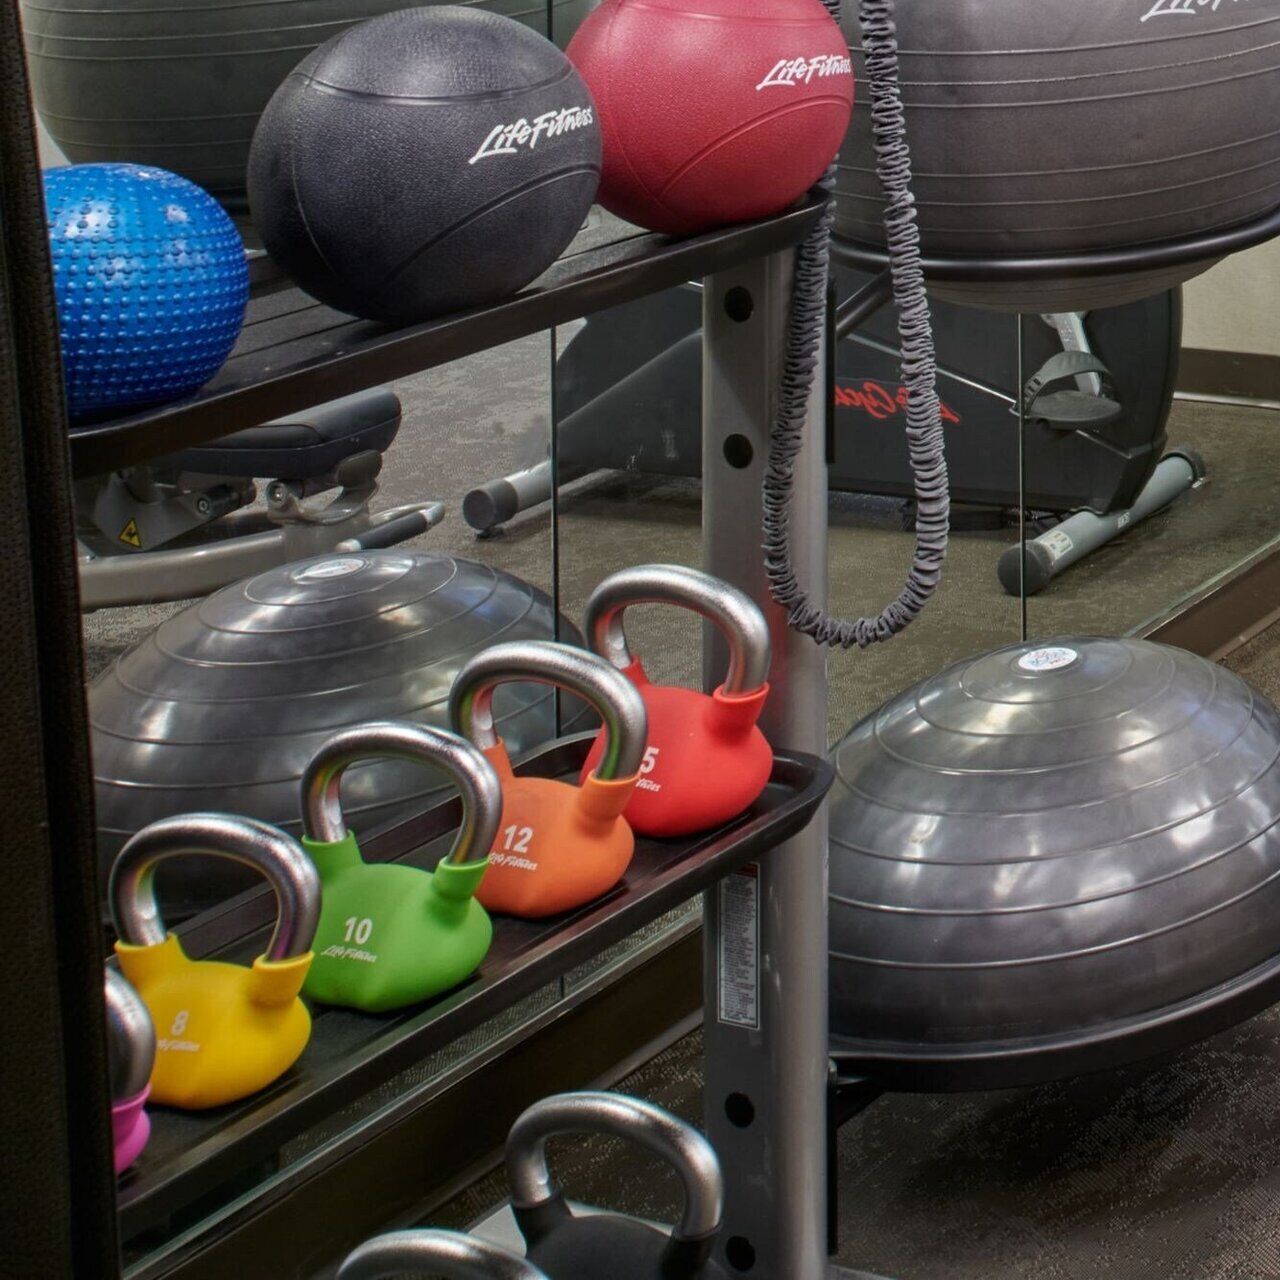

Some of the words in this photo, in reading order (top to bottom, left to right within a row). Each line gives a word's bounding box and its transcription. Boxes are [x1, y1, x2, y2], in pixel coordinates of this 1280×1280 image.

[640, 746, 660, 773] 5
[504, 824, 533, 853] 12
[344, 916, 373, 945] 10
[171, 1009, 190, 1036] 8
